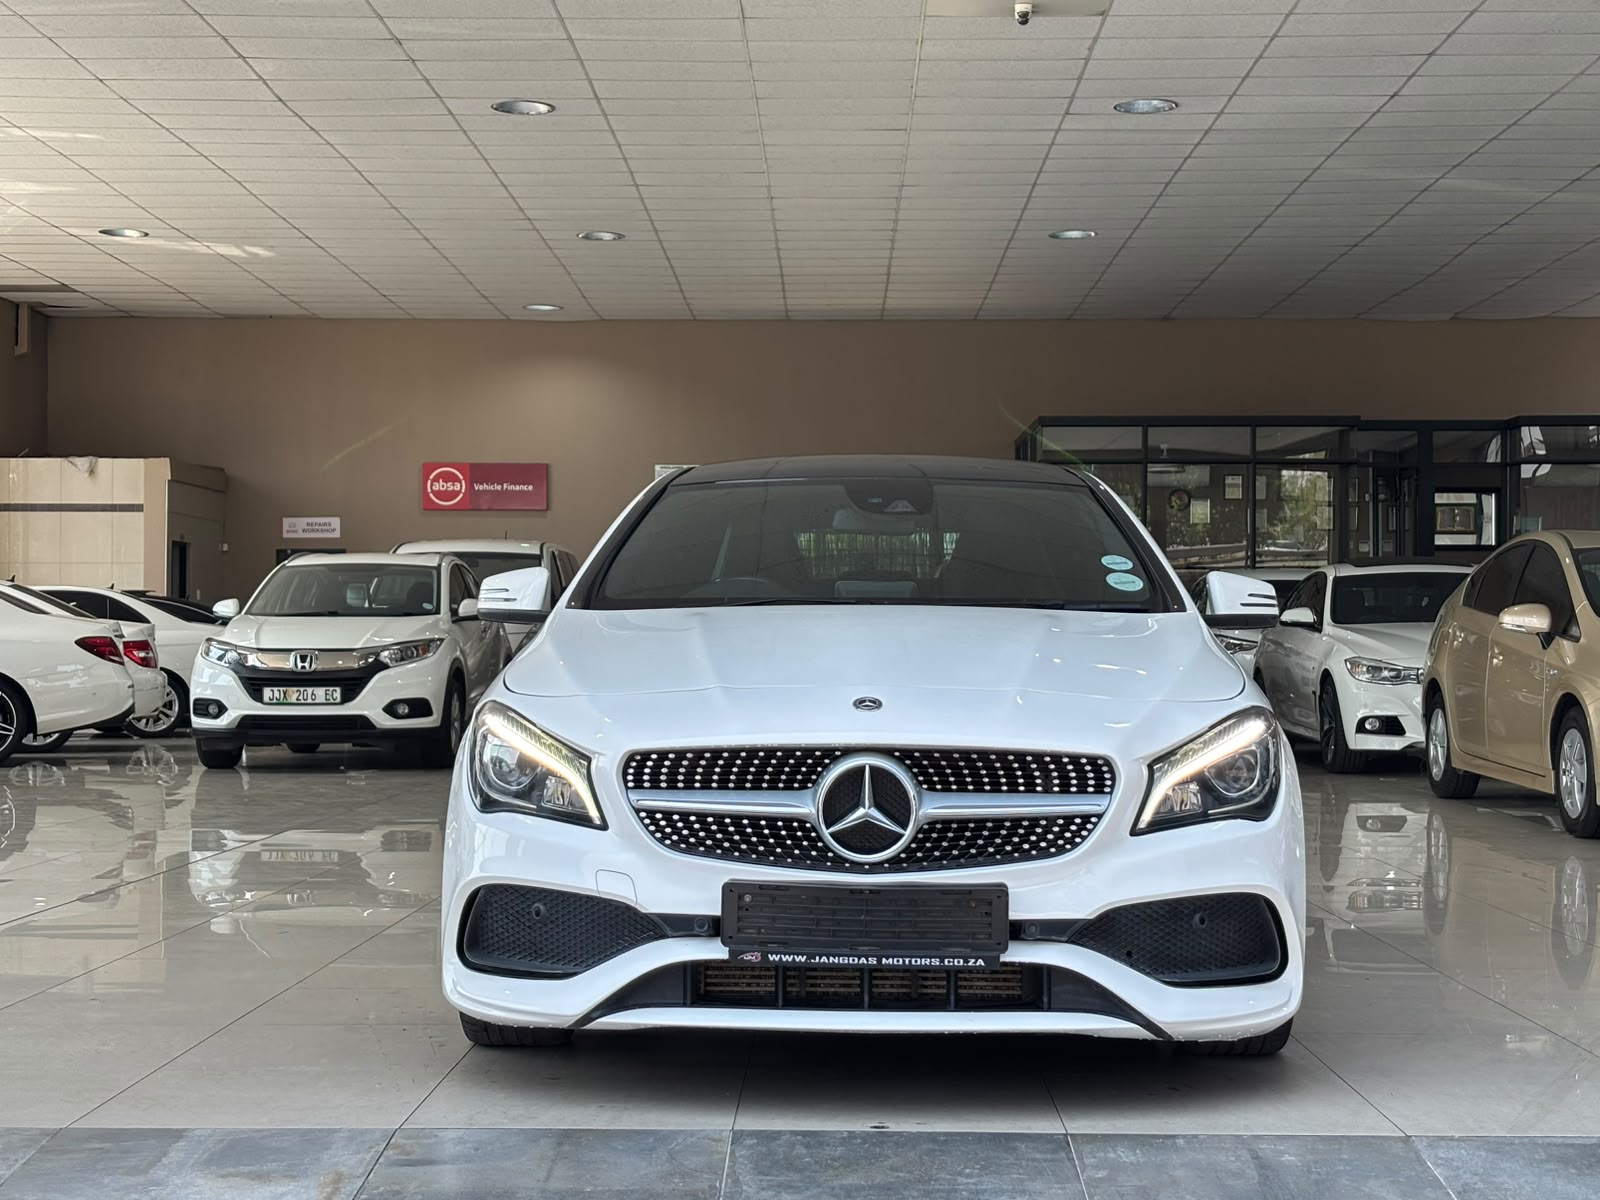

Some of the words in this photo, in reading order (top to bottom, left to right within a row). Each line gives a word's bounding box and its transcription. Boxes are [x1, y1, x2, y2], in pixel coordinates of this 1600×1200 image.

[432, 478, 461, 491] absa
[473, 482, 502, 491] Vehicle
[503, 482, 534, 491] Finance
[268, 688, 288, 702] JJX
[296, 688, 317, 702] 206
[325, 688, 338, 702] EC
[881, 956, 986, 967] MOTORS.CO.ZA
